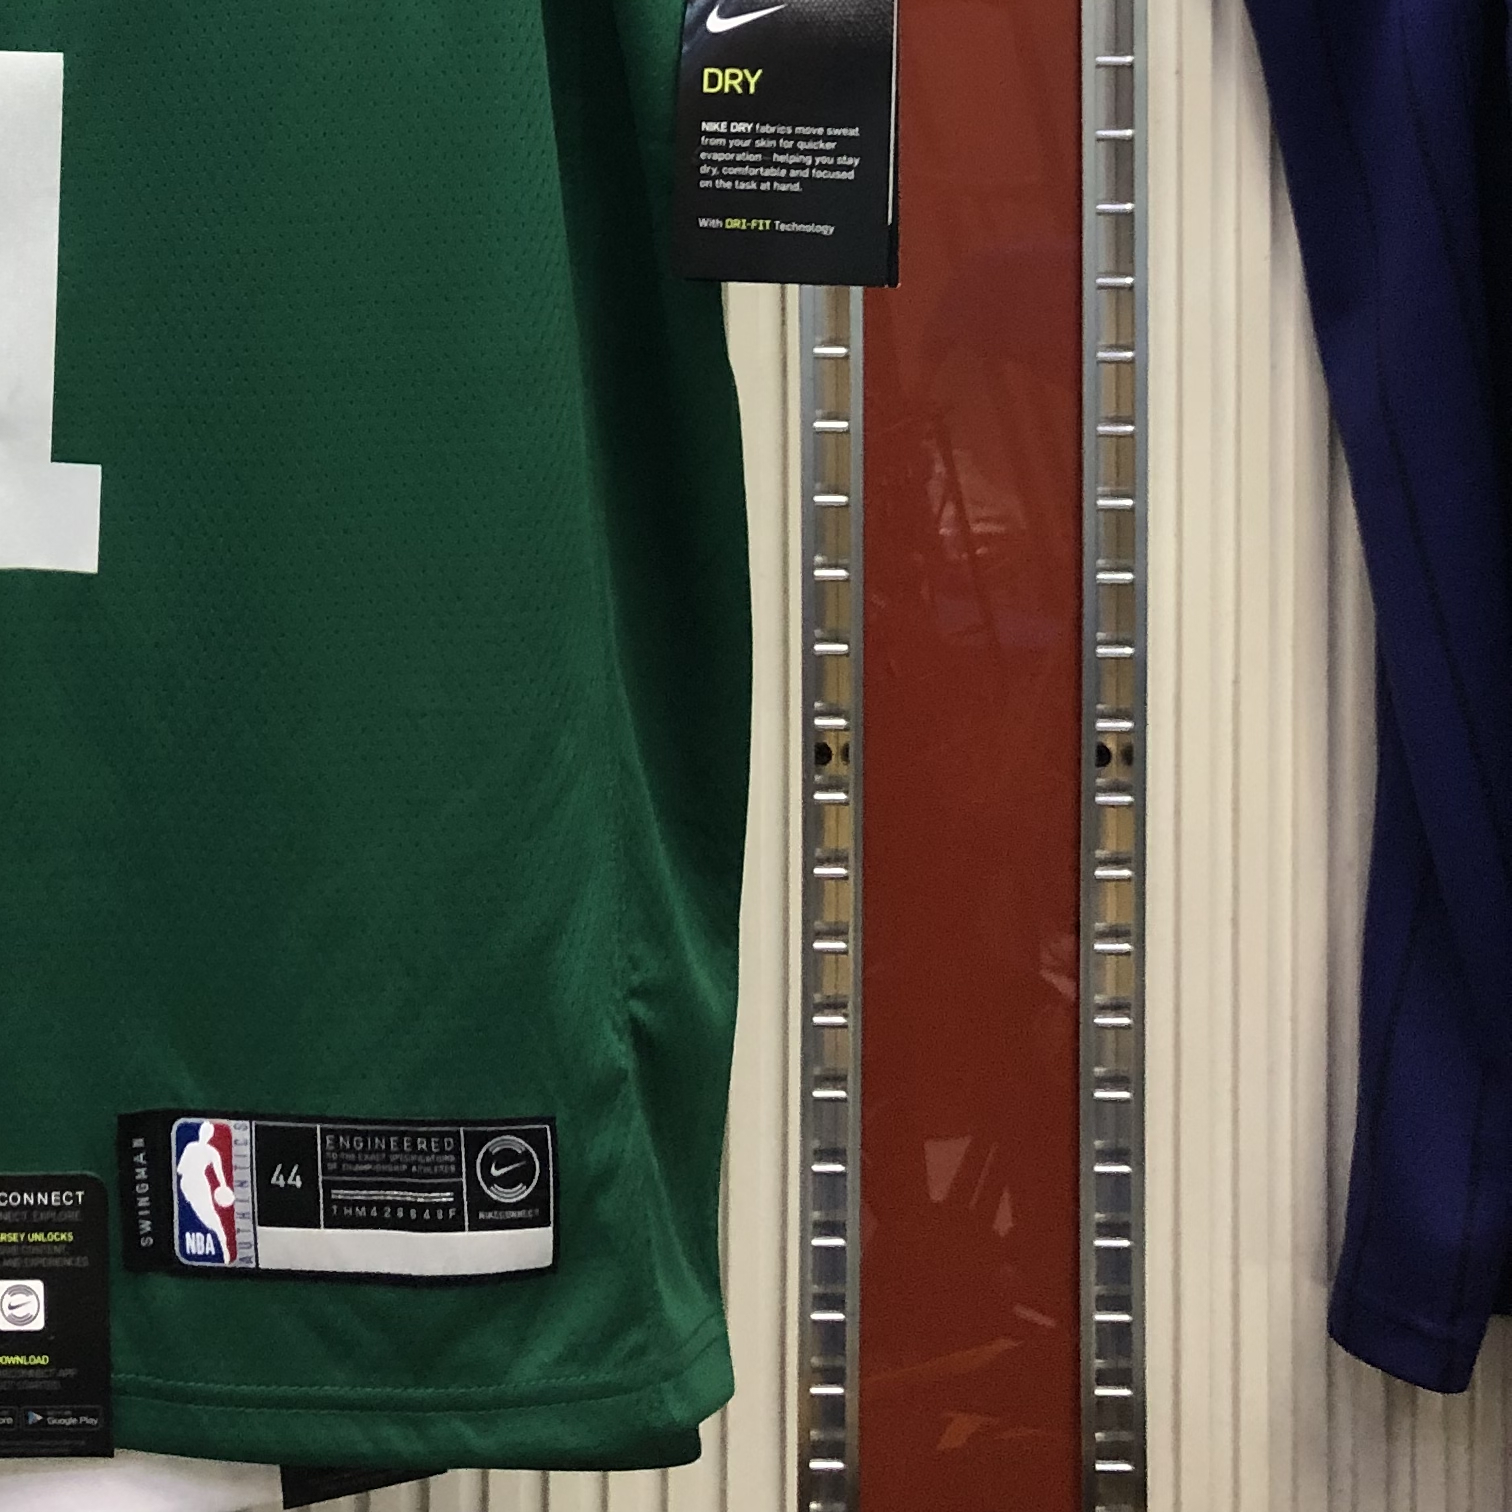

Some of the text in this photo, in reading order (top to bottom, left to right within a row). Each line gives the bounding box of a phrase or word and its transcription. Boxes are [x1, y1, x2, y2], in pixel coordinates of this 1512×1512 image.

[702, 68, 763, 94] DRY
[701, 121, 860, 136] NIKE DRY fabrics move sweat
[701, 136, 837, 150] from your skin for quicker
[699, 152, 860, 167] evaporation helping you stay
[699, 164, 854, 180] dry, comfortable and focused
[699, 179, 803, 192] on the task at hand.
[698, 218, 835, 235] With DRI-FIT Technology
[326, 1135, 454, 1152] ENGINEERED
[271, 1164, 302, 1188] 44
[132, 1138, 153, 1247] SWINGMAN
[28, 1232, 74, 1242] UNLOCKS
[185, 1232, 215, 1255] NBA
[80, 1416, 98, 1426] Play
